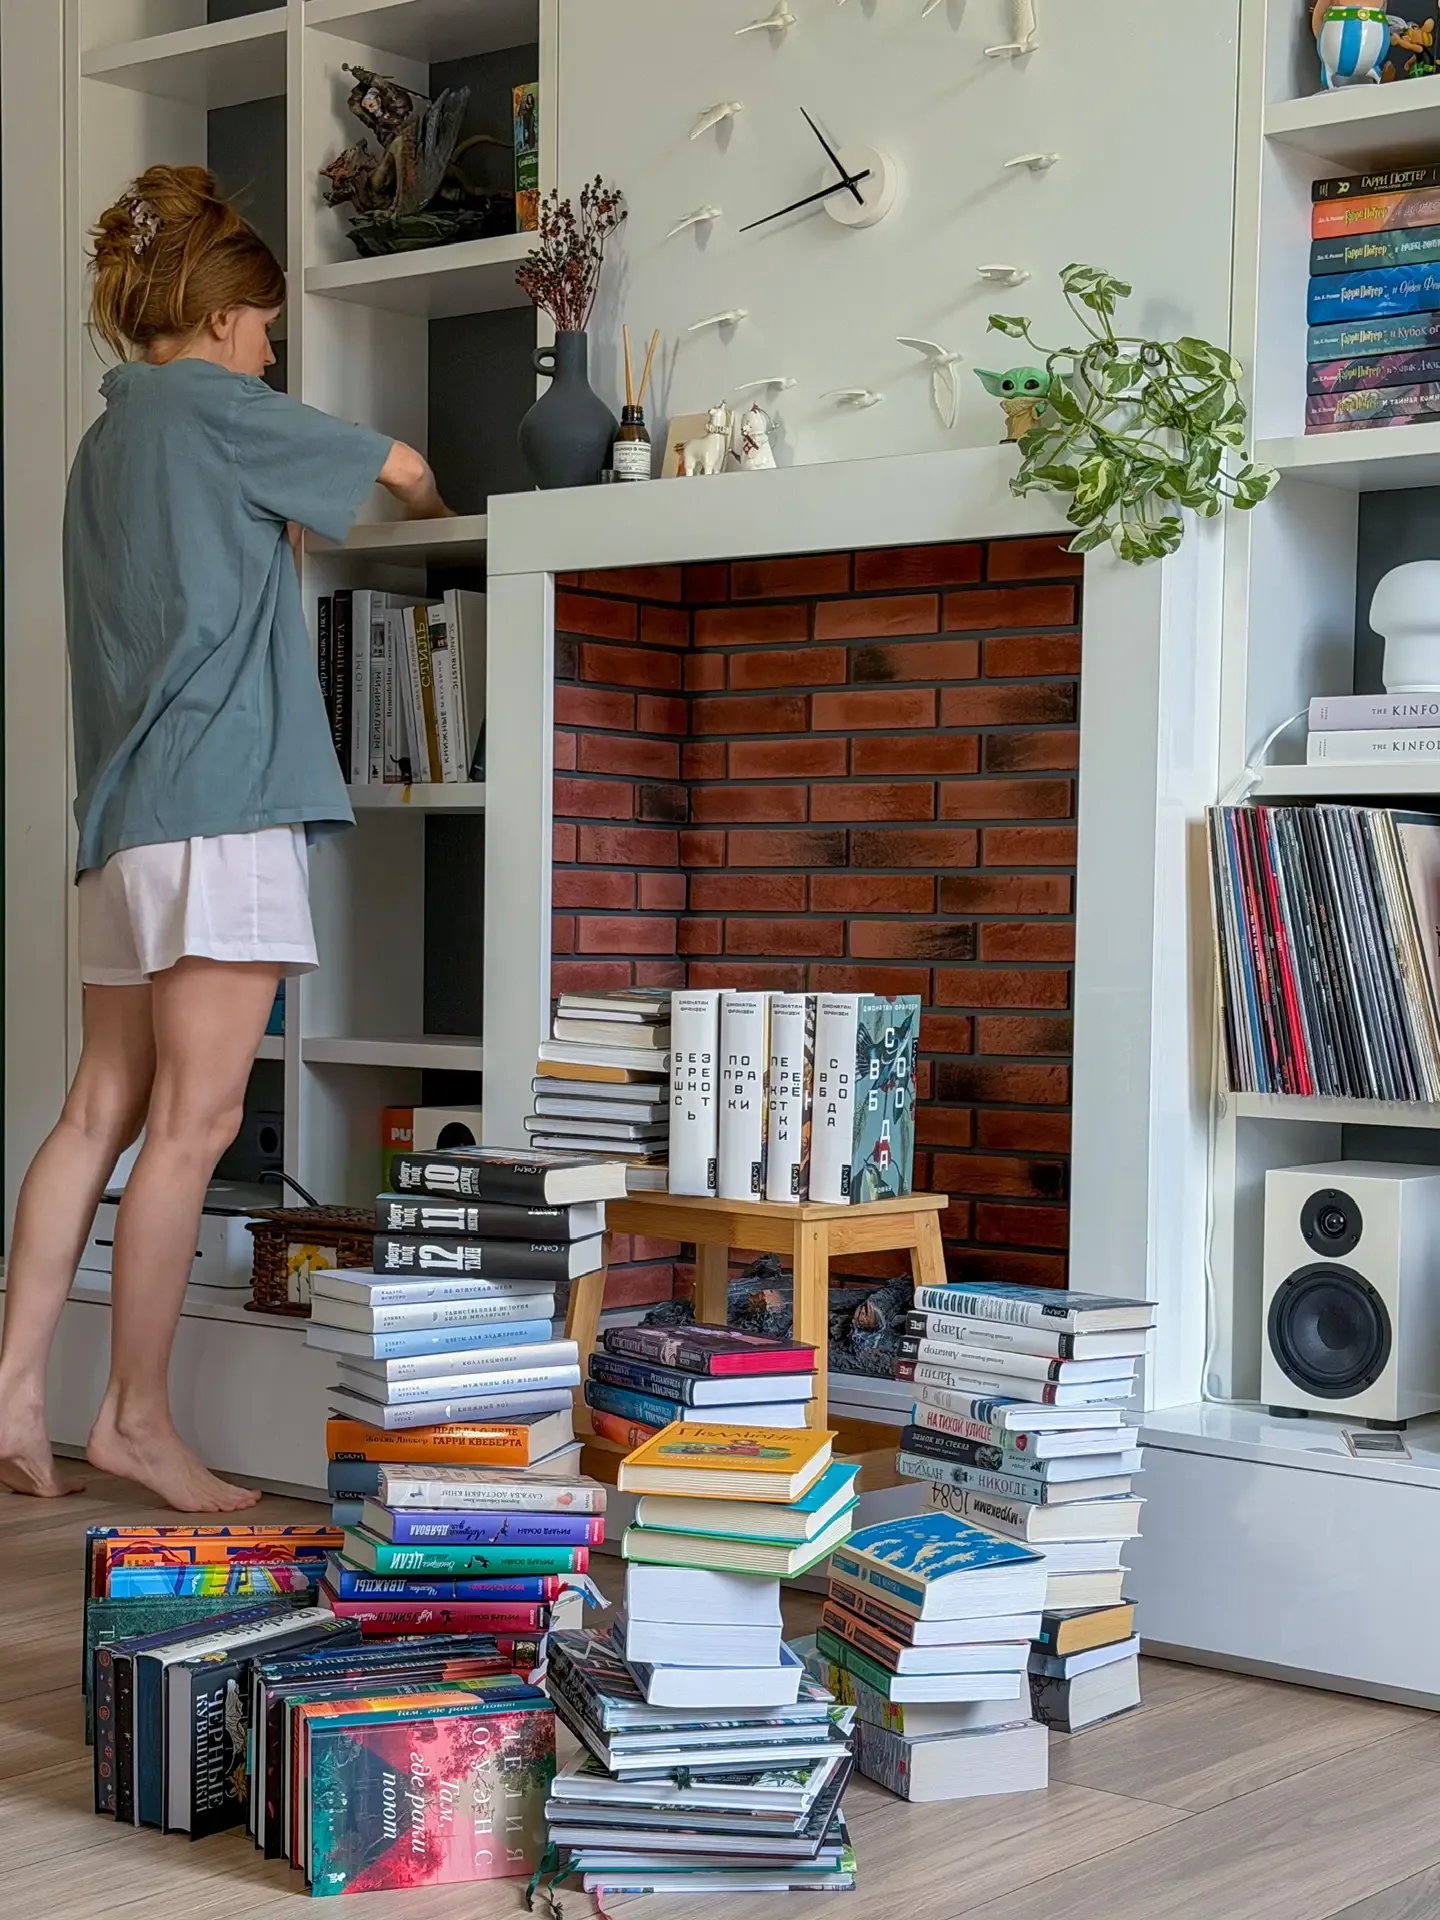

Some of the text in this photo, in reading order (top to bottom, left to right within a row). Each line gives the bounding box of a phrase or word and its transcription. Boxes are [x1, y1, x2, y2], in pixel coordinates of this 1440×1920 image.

[1361, 174, 1388, 188] ГАРРИ
[1390, 169, 1426, 183] ПОТТЕР
[1341, 287, 1359, 304] Гарри
[1360, 285, 1383, 299] Поттер
[415, 621, 431, 688] СТИЛЬ
[355, 651, 364, 693] HOME
[335, 623, 346, 751] АНАТОМИЯ ЦВЕТА
[373, 671, 382, 749] МИНИМАЛИЗМ
[440, 710, 449, 764] КНИЖНЫЕ
[400, 1161, 412, 1189] Роберт
[410, 1165, 423, 1187] Голд
[424, 1163, 460, 1193] 10
[387, 1203, 403, 1230] Роберт
[402, 1207, 418, 1228] Голд
[421, 1207, 465, 1231] 11
[385, 1242, 400, 1269] Роберт
[399, 1246, 416, 1267] Голд
[418, 1244, 464, 1271] 12
[464, 1246, 482, 1271] ТАЙН
[455, 1285, 492, 1294] ОТПУСКАЙ
[922, 1289, 978, 1316] ПАНОРАМА
[445, 1335, 468, 1344] ЦВЕТЫ
[932, 1319, 967, 1341] Лавр
[462, 1356, 517, 1366] КОЛЛЕКЦИОНЕР
[923, 1344, 960, 1360] Авиатор
[462, 1380, 500, 1389] МУЖЧИНЫ
[920, 1368, 956, 1387] Чагин
[457, 1403, 495, 1412] КНИЖНЫЙ
[926, 1411, 993, 1442] НА ТИХОЙ УЛИЦЕ
[433, 1437, 523, 1448] ГАРРИ КВЕБЕРТА
[902, 1460, 1028, 1497] ГЕЙМАН НИКОГДЕ
[440, 1489, 543, 1500] СЛУЖБА ДОСТАВКИ КНИГ
[931, 1481, 1019, 1526] мураками 1Q84
[409, 1523, 449, 1537] ДЬЯВОЛА
[517, 1526, 572, 1536] РИЧАРД ОСМАН
[389, 1550, 424, 1571] ЦЕЛИ
[500, 1558, 555, 1567] РИЧАРД ОСМАН
[353, 1578, 408, 1593] ДВАЖДЫ
[426, 1706, 445, 1716] где
[447, 1703, 479, 1716] раки
[482, 1701, 517, 1711] поют
[196, 1692, 208, 1814] КУВШИНКИ
[208, 1687, 224, 1810] ЧЕРНЫЕ
[381, 1771, 398, 1840] поют
[404, 1751, 433, 1854] где раки
[438, 1777, 461, 1829] Там,
[471, 1726, 495, 1868] ОУЭНС
